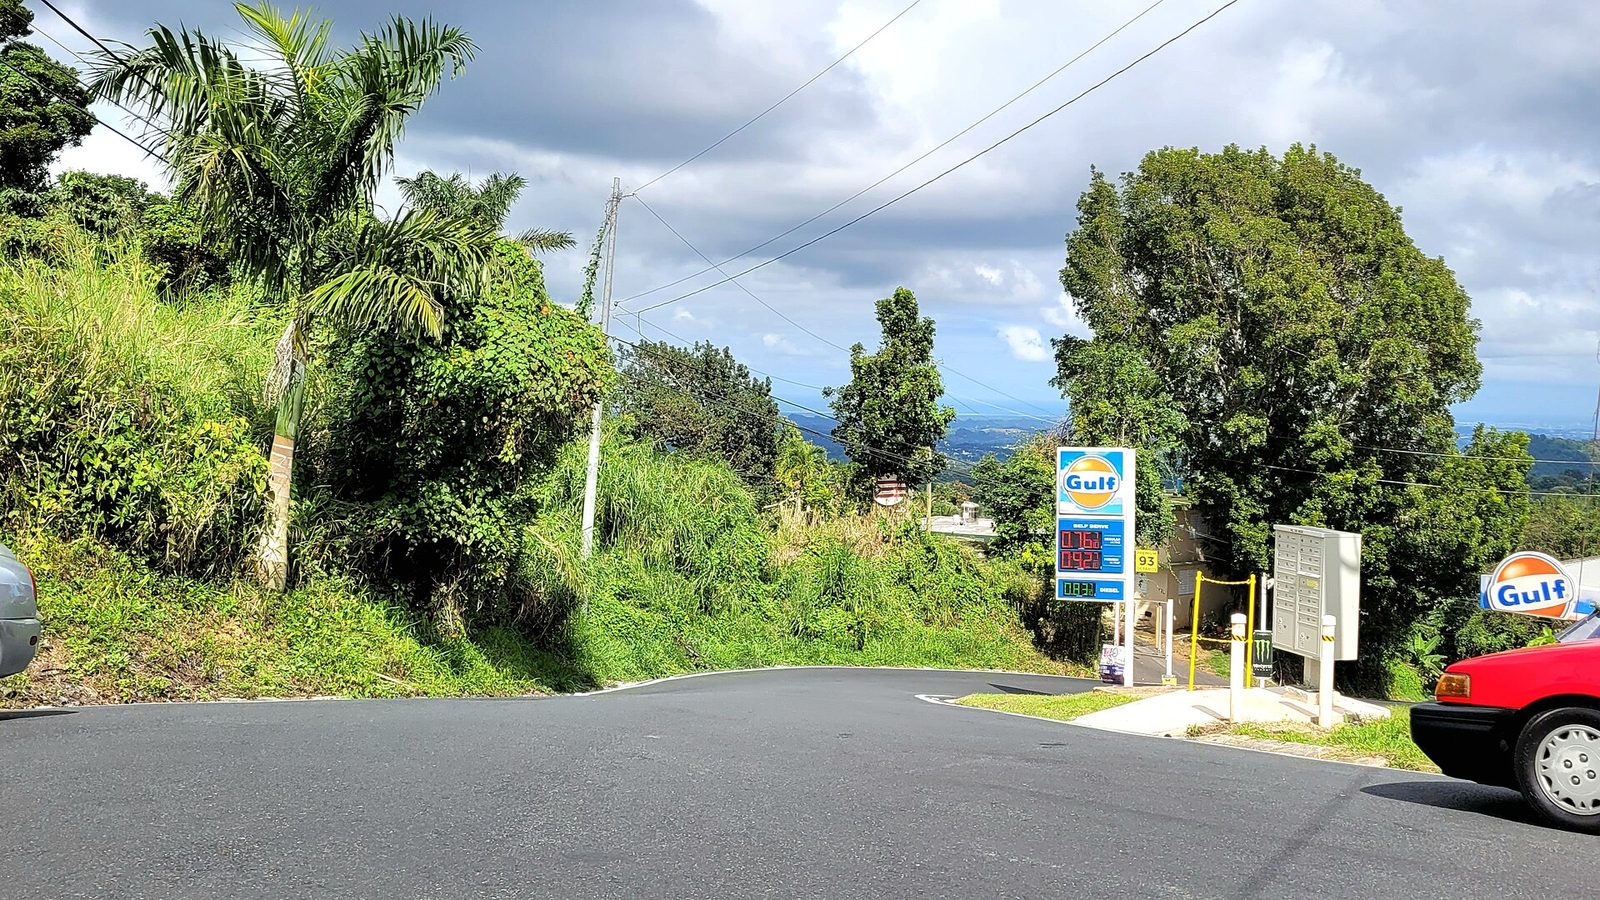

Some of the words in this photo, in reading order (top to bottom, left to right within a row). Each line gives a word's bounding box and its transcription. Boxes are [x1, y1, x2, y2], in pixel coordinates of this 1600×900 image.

[1066, 474, 1116, 490] Gulf
[1139, 556, 1155, 566] 93
[1497, 579, 1566, 607] Gulf
